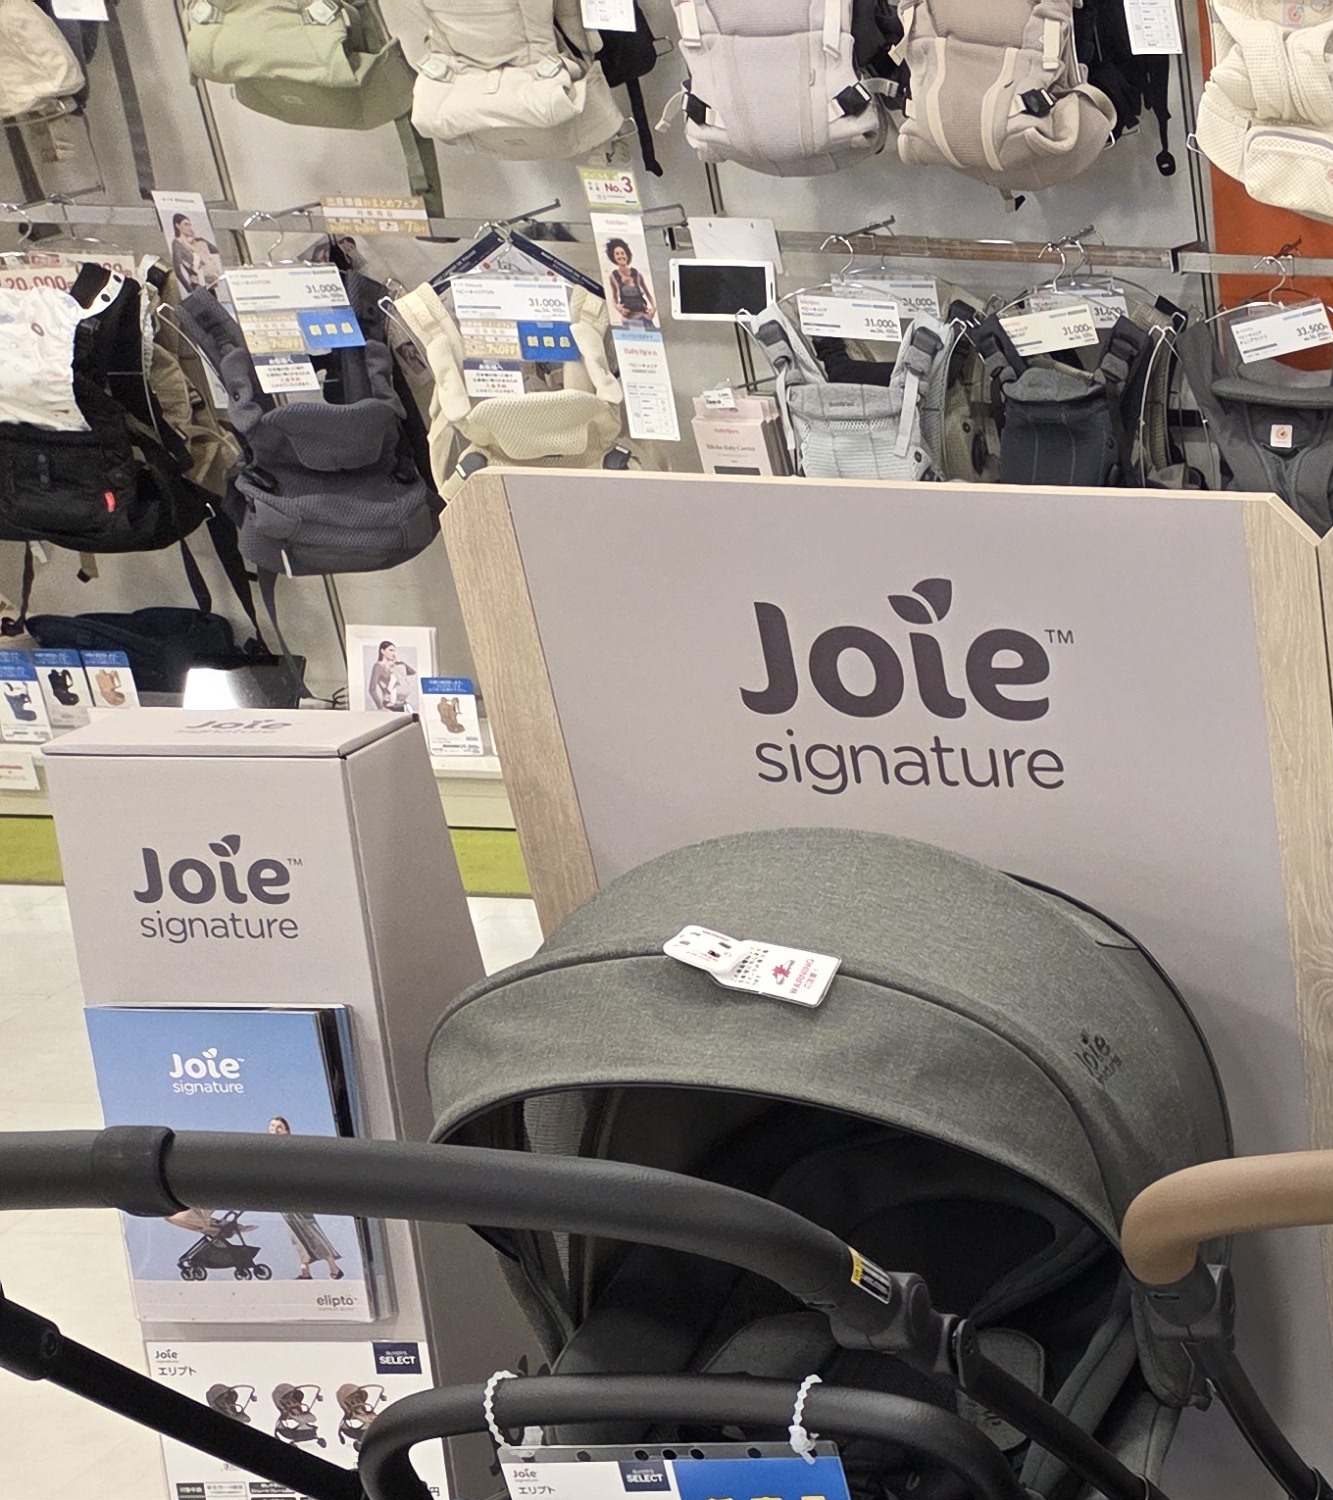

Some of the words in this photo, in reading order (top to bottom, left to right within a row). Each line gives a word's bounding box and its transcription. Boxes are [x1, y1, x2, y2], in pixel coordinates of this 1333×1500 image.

[739, 577, 1050, 722] Joie
[755, 728, 1065, 795] signature
[133, 834, 291, 905] Joie
[140, 910, 299, 944] signature
[169, 1048, 241, 1079] Joie
[172, 1080, 245, 1095] signature
[316, 1294, 355, 1311] elipto
[155, 1348, 178, 1359] Joie
[379, 1355, 416, 1366] SELECT
[157, 1365, 197, 1377] エリプト
[513, 1468, 537, 1478] Joie
[626, 1473, 664, 1483] SELECT
[518, 1485, 556, 1495] エリプト
